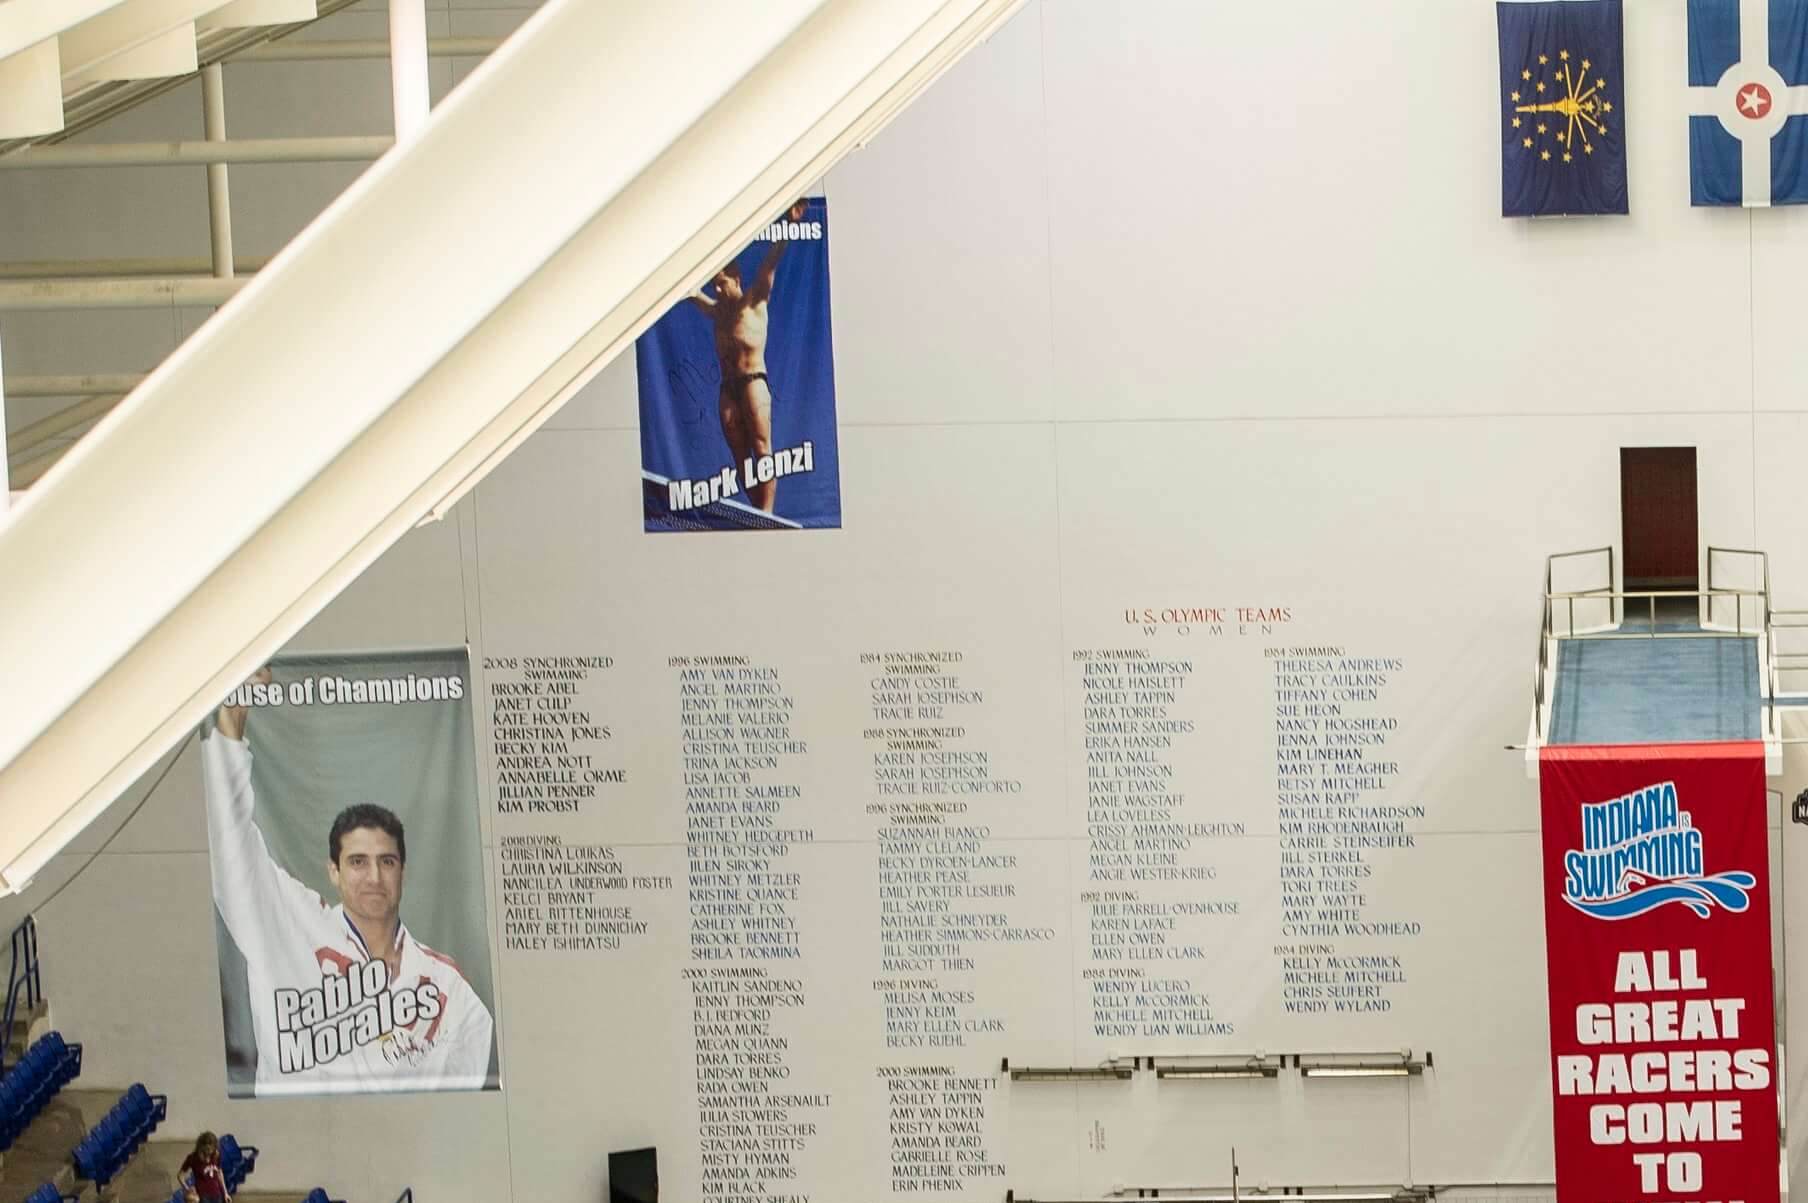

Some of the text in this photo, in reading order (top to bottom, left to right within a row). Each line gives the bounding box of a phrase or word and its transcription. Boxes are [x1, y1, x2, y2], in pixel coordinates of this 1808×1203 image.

[668, 442, 815, 512] Mark Lenzi
[1161, 608, 1227, 624] OLYMPIC
[1236, 608, 1292, 624] TEAMS
[483, 656, 614, 670] 2008 SYNCHRONIZED
[1275, 659, 1403, 672] THERESA ANDREWS
[525, 670, 588, 681] SWIMMING
[680, 669, 778, 681] AMY VAN DYKEN
[223, 674, 464, 708] ouse of Champions
[491, 682, 579, 696] BROOKE ABEL
[495, 697, 571, 711] JANET CULP
[493, 712, 590, 725] KATE HOOVEN
[1276, 719, 1398, 731] NANCY HOGSHEAD
[1085, 721, 1194, 733] SUMMER SANDERS
[494, 726, 611, 742] CHRISTINA JONES
[494, 742, 569, 755] BECKY KIM
[1085, 737, 1171, 749] ERIKA HANSEN
[1277, 748, 1362, 761] KIM LINEHAN
[497, 756, 592, 769] ANDREA NOTT
[1278, 762, 1315, 776] MARY
[1335, 762, 1399, 776] MEAGHER
[498, 770, 627, 784] ANNABELLE ORME
[499, 785, 596, 800] JILLIAN PENNER
[498, 800, 579, 813] KIM PROBST
[1279, 806, 1425, 820] MICHELE RICHARDSON
[1582, 781, 1680, 853] INDIANA
[502, 862, 622, 875] LAURA WILKINSON
[1565, 828, 1703, 900] SWIMMING
[1283, 909, 1359, 922] AMY WHITE
[1282, 923, 1421, 936] CYNTHIA WOODHEAD
[1614, 949, 1707, 993] ALL
[275, 959, 389, 1031] Pablo
[1285, 1000, 1391, 1013] WENDY WYLAND
[1576, 997, 1746, 1044] GREAT
[277, 982, 441, 1073] Morales
[1094, 1023, 1234, 1036] WENDY LIAN WILLIAMS
[1558, 1048, 1771, 1095] RACERS
[888, 1078, 998, 1091] BROOKE BENNETT
[890, 1107, 984, 1119] AMY VAN DYKEN
[1589, 1100, 1743, 1145] COME
[702, 1154, 789, 1166] MISTY HYMAN
[703, 1168, 797, 1180] AMANDA ADKINS
[1633, 1152, 1703, 1193] TO
[702, 1182, 766, 1193] KIM BLACK
